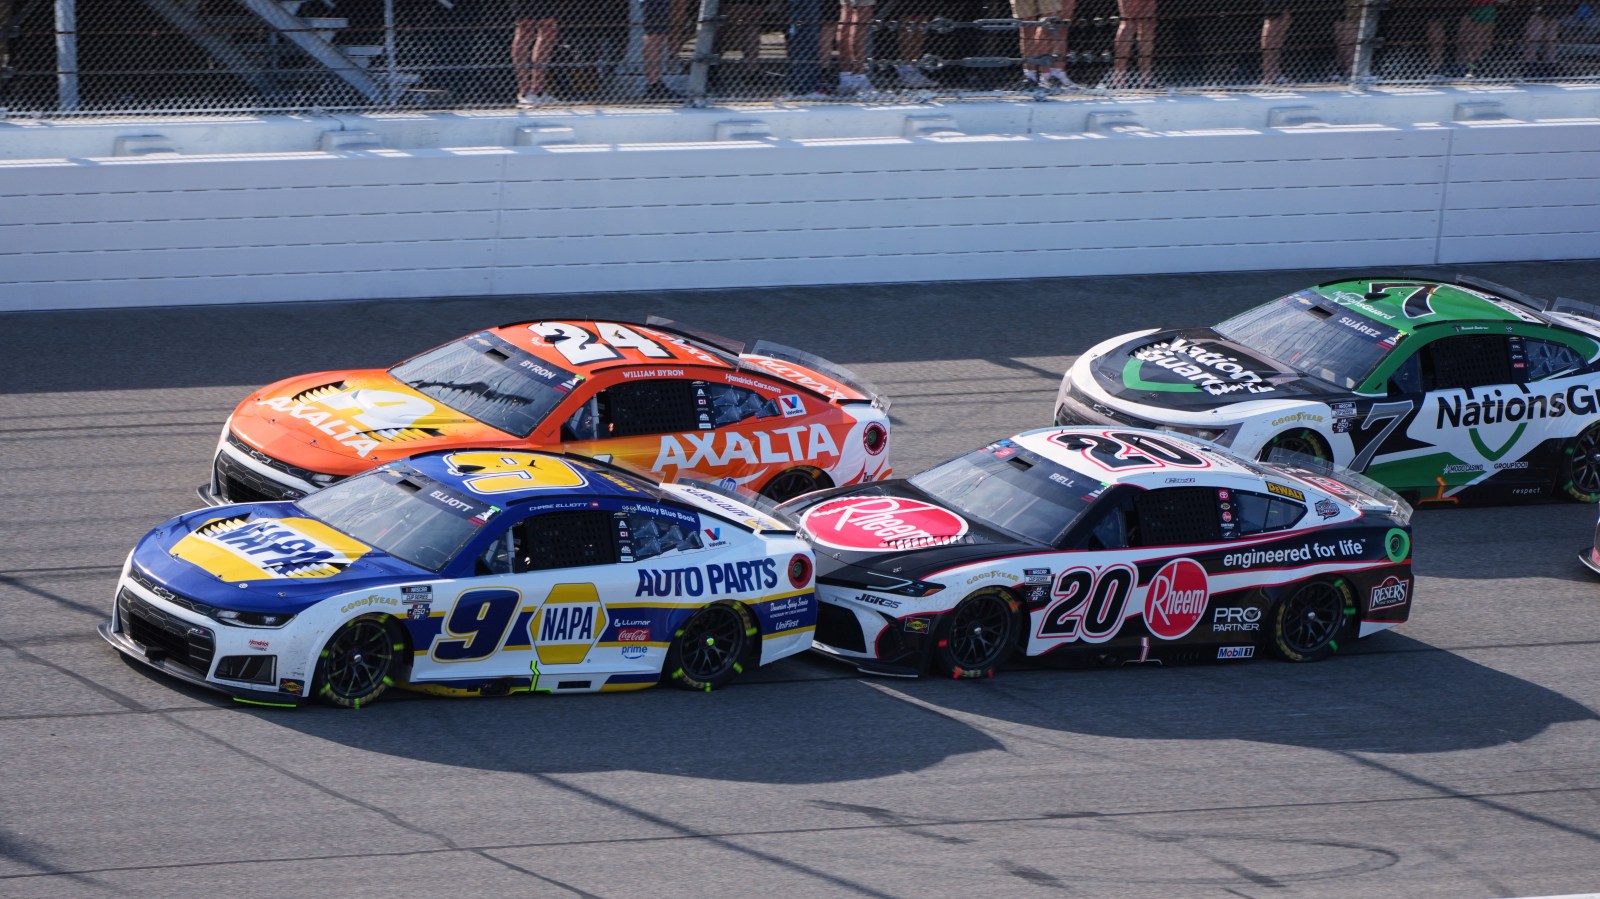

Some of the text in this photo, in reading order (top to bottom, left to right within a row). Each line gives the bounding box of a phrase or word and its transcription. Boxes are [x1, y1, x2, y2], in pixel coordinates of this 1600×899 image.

[1369, 282, 1443, 319] 7
[1338, 316, 1382, 338] SUÁREZ
[527, 322, 679, 366] 24
[519, 360, 557, 380] BYRON
[623, 369, 685, 379] WILLIAM BYRON
[1271, 411, 1324, 427] GOODYEAR
[1436, 384, 1600, 430] NationsG
[256, 396, 381, 458] AXALTA
[1344, 399, 1415, 475] 7
[651, 423, 840, 472] AXALTA
[1046, 431, 1212, 473] 20
[441, 451, 590, 495] 9
[1049, 472, 1078, 488] BELL
[429, 489, 475, 512] ELLIOTT
[529, 503, 554, 511] CHASE
[636, 503, 660, 516] Kelley
[660, 507, 677, 518] Blue
[677, 512, 696, 523] Book
[811, 497, 940, 543] Rheem
[1223, 542, 1312, 569] engineered
[1313, 540, 1336, 558] for
[635, 557, 778, 598] AUTO PARTS
[966, 570, 1020, 585] GOODYEAR
[341, 594, 399, 613] GOODYEAR
[1035, 563, 1140, 644] 20
[1148, 562, 1206, 626] Rheem
[431, 586, 523, 664] 9
[541, 605, 594, 642] NAPA
[775, 619, 800, 631] UniFirst
[1214, 606, 1262, 623] PRO
[248, 639, 270, 648] Hendrick
[621, 644, 648, 656] prime
[1218, 647, 1253, 658] Mobil 1
